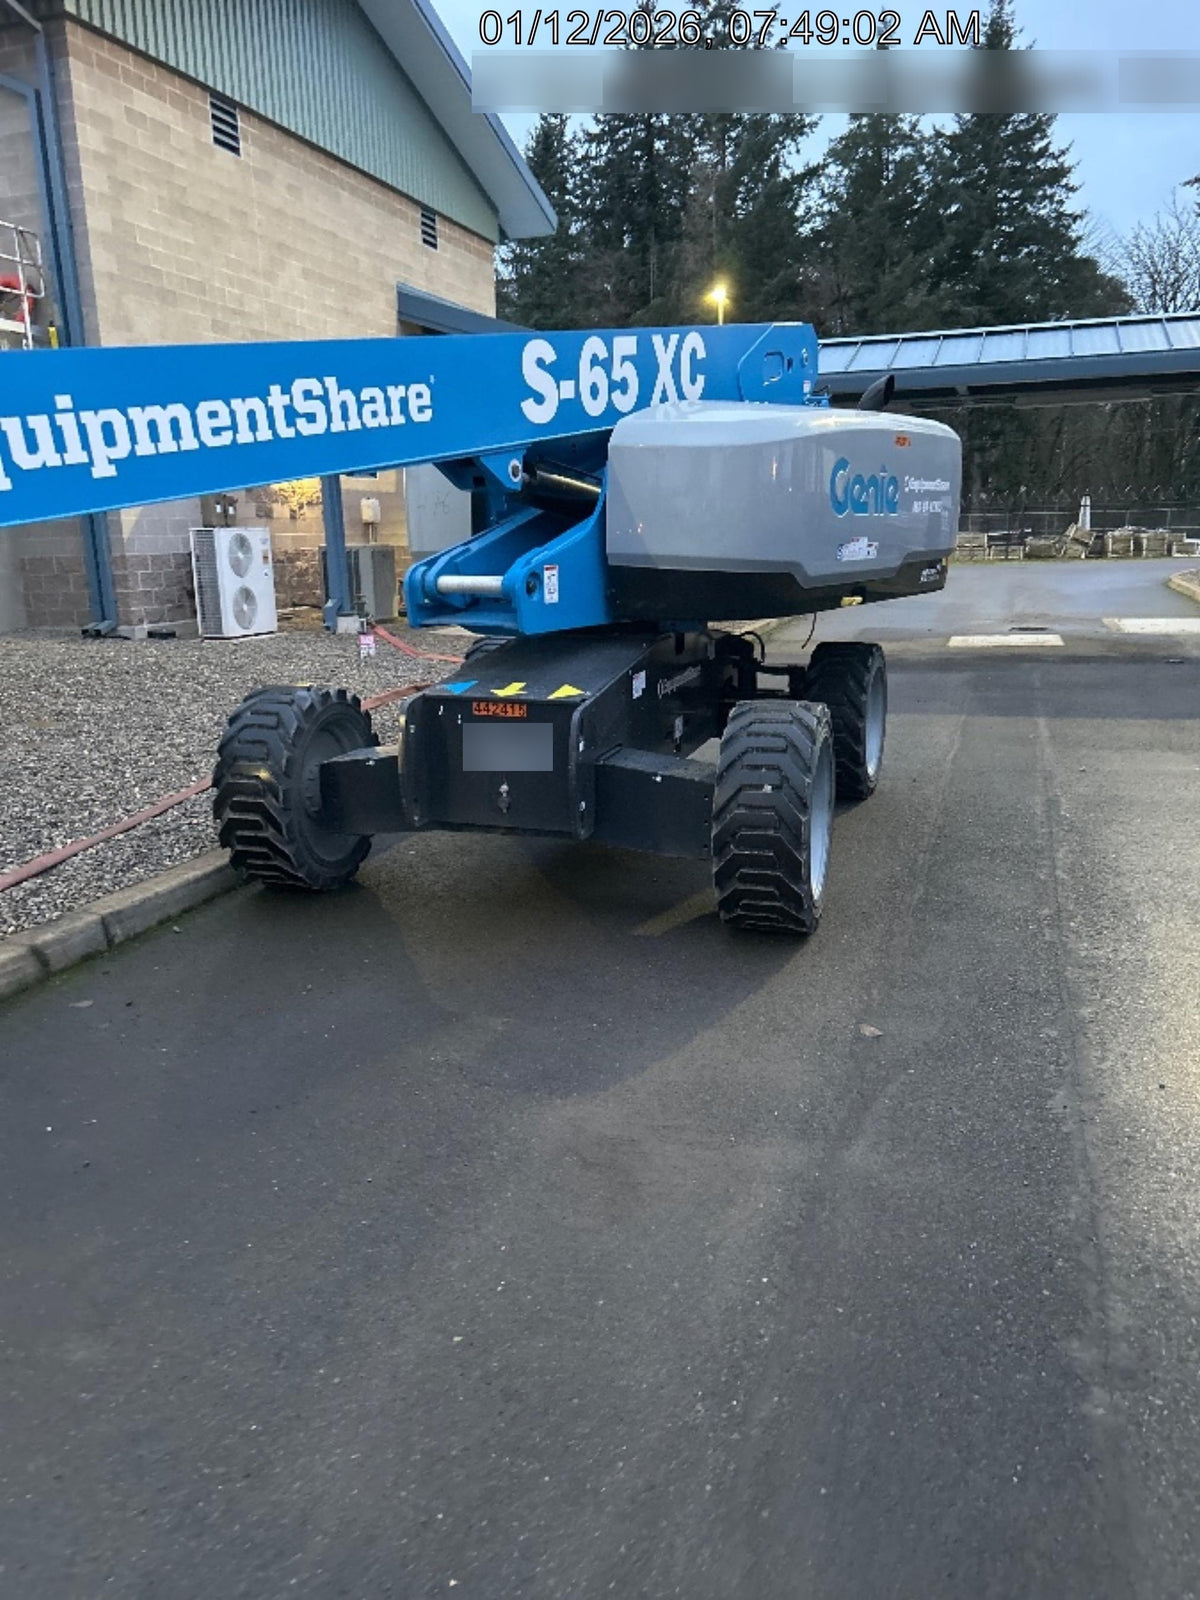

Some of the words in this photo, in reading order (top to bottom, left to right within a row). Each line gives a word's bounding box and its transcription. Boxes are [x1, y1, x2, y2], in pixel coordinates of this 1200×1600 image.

[520, 335, 639, 425] S-65
[650, 331, 707, 408] XC
[0, 376, 433, 491] uipmentShare
[830, 457, 900, 518] Genie
